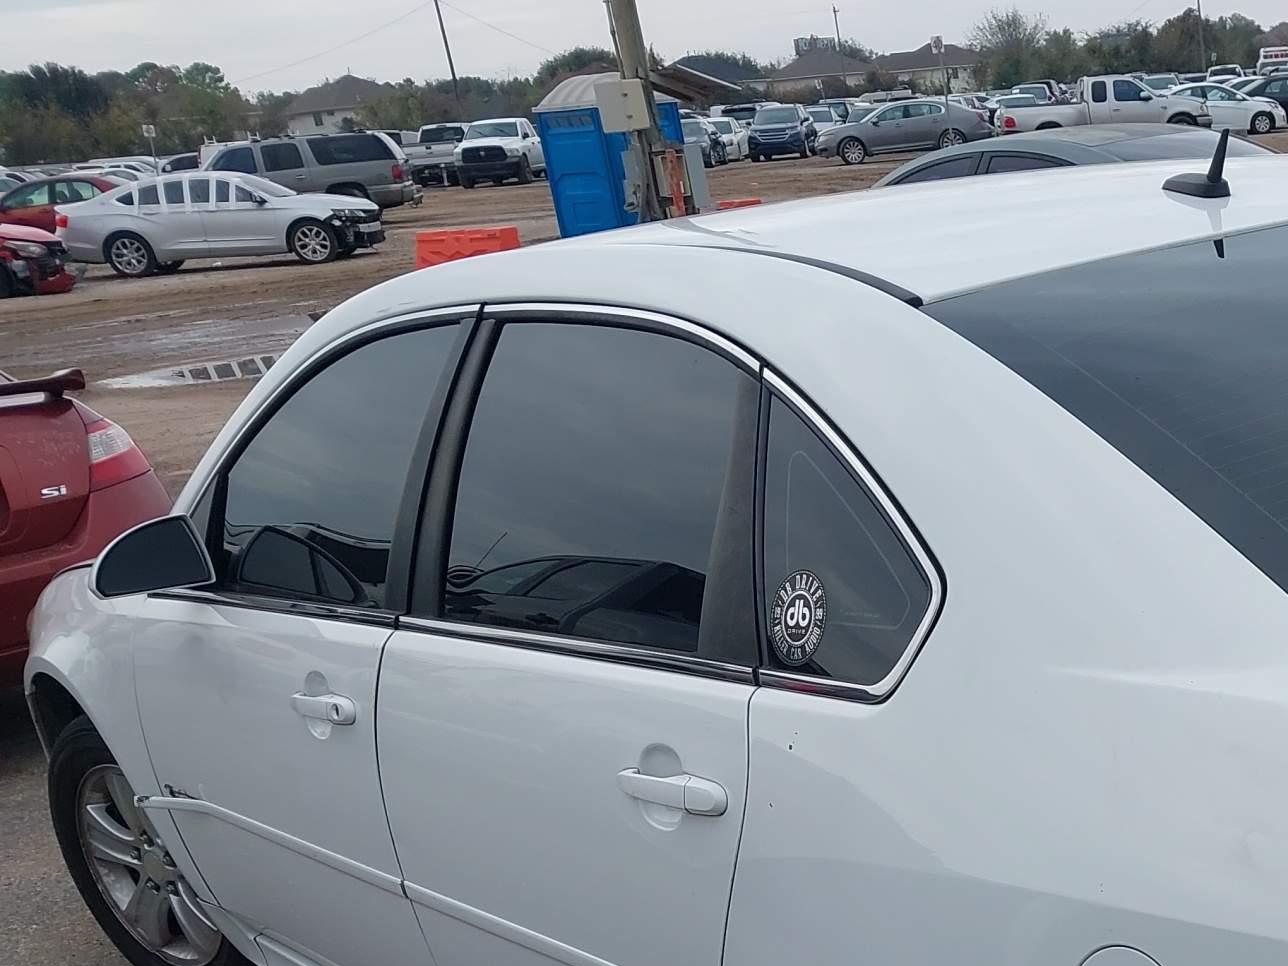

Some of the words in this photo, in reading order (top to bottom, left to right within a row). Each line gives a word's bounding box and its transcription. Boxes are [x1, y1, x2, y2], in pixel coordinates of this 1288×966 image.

[40, 484, 67, 499] Si
[780, 582, 792, 602] DB
[795, 574, 822, 601] DRIVE
[787, 599, 810, 627] db
[774, 624, 789, 656] KILLER
[790, 647, 802, 660] CAR
[805, 627, 820, 654] AUDIO
